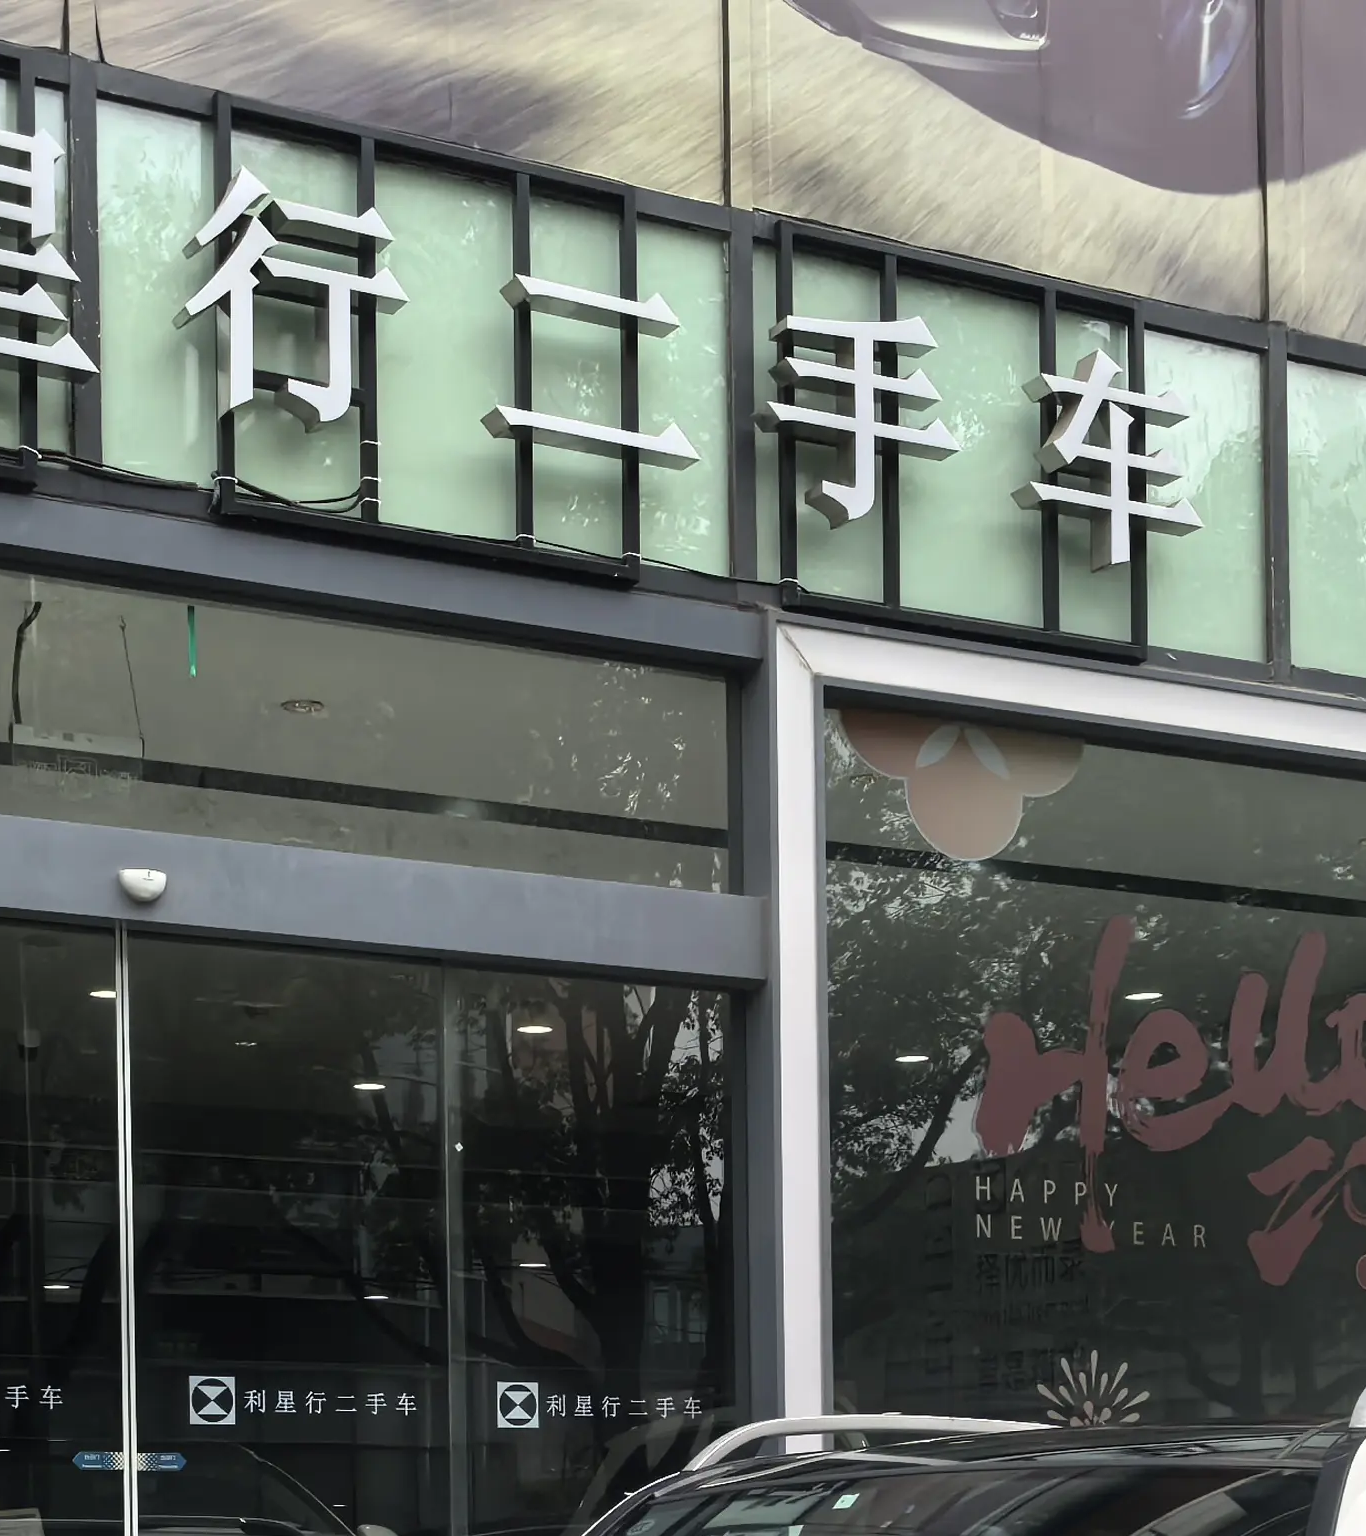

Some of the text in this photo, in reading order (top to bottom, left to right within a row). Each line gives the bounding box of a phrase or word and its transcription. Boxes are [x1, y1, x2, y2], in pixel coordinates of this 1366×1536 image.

[975, 1175, 1119, 1207] HAPPY
[975, 1213, 1063, 1242] NEW
[243, 1388, 418, 1416] 利星行二手车
[545, 1393, 703, 1420] 利星行二手车
